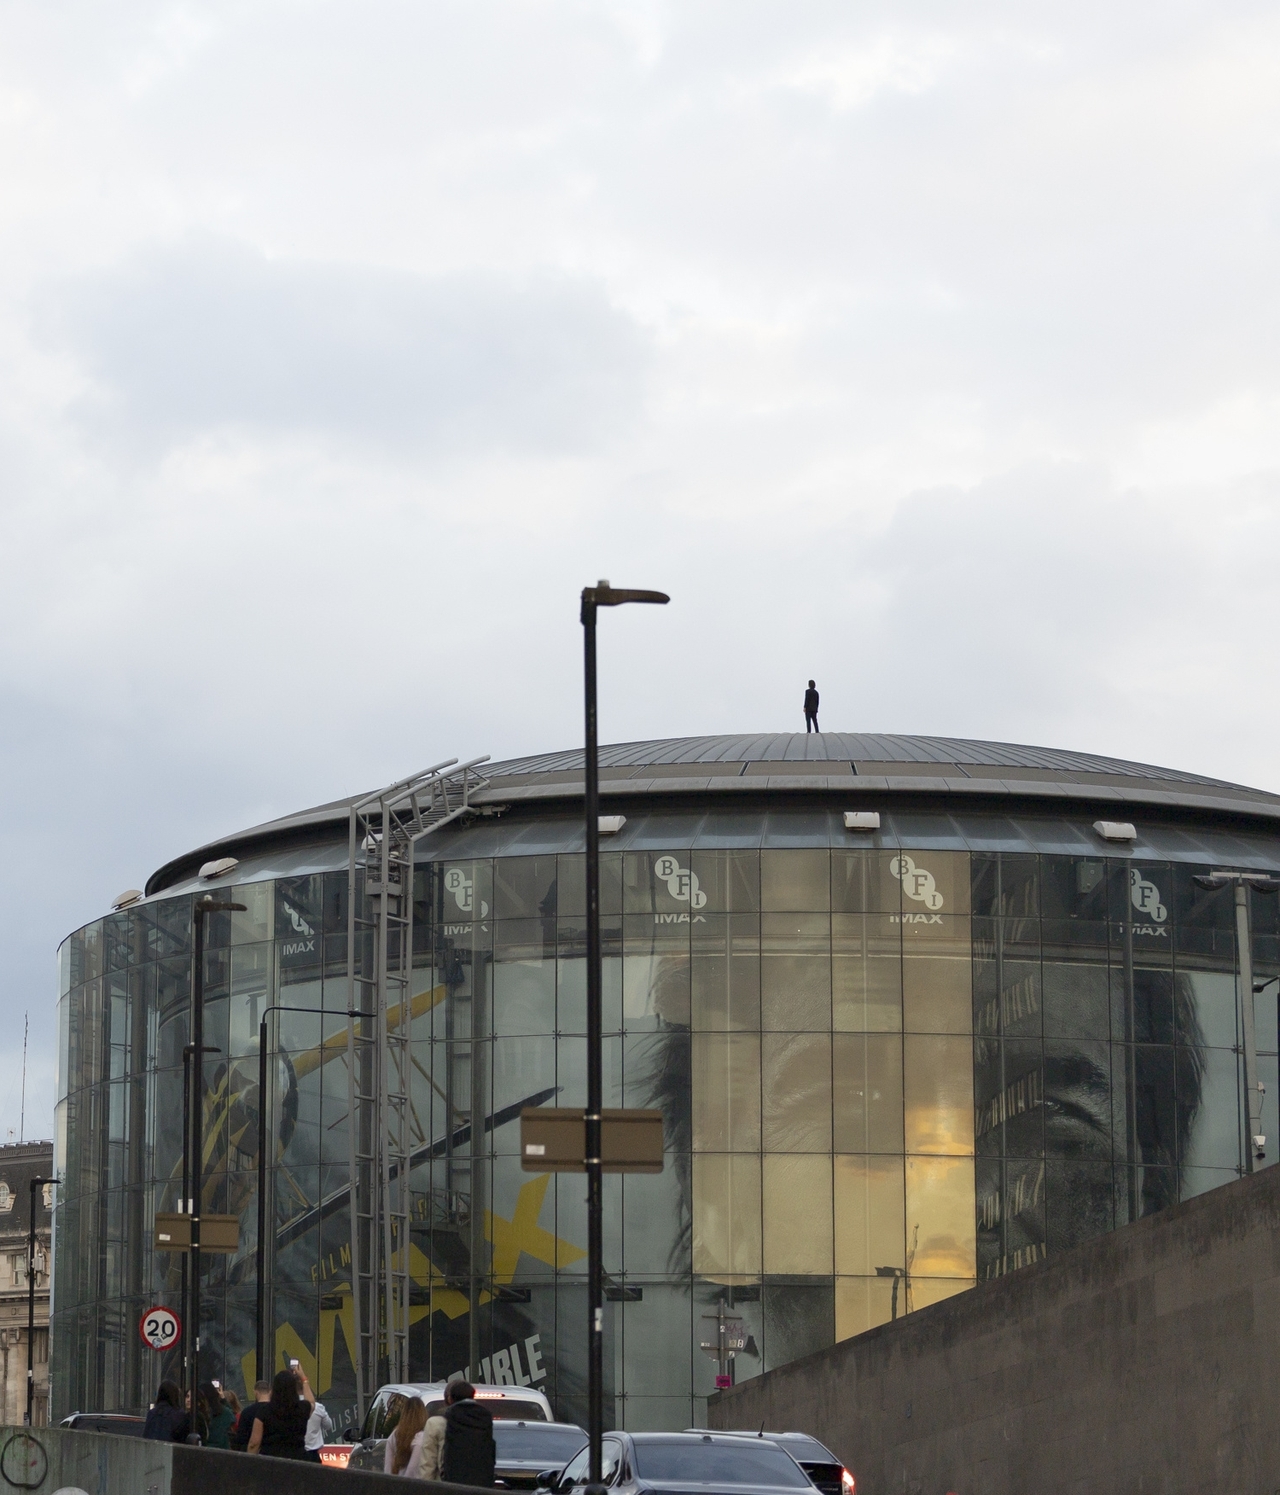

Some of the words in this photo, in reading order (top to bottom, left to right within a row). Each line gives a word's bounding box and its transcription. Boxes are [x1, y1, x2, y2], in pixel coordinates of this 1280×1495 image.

[658, 858, 704, 907] BFI
[894, 857, 941, 908] BFI
[654, 913, 707, 924] IMAX
[890, 913, 943, 925] IMAX
[283, 939, 315, 956] IMAX
[147, 1319, 175, 1337] 20
